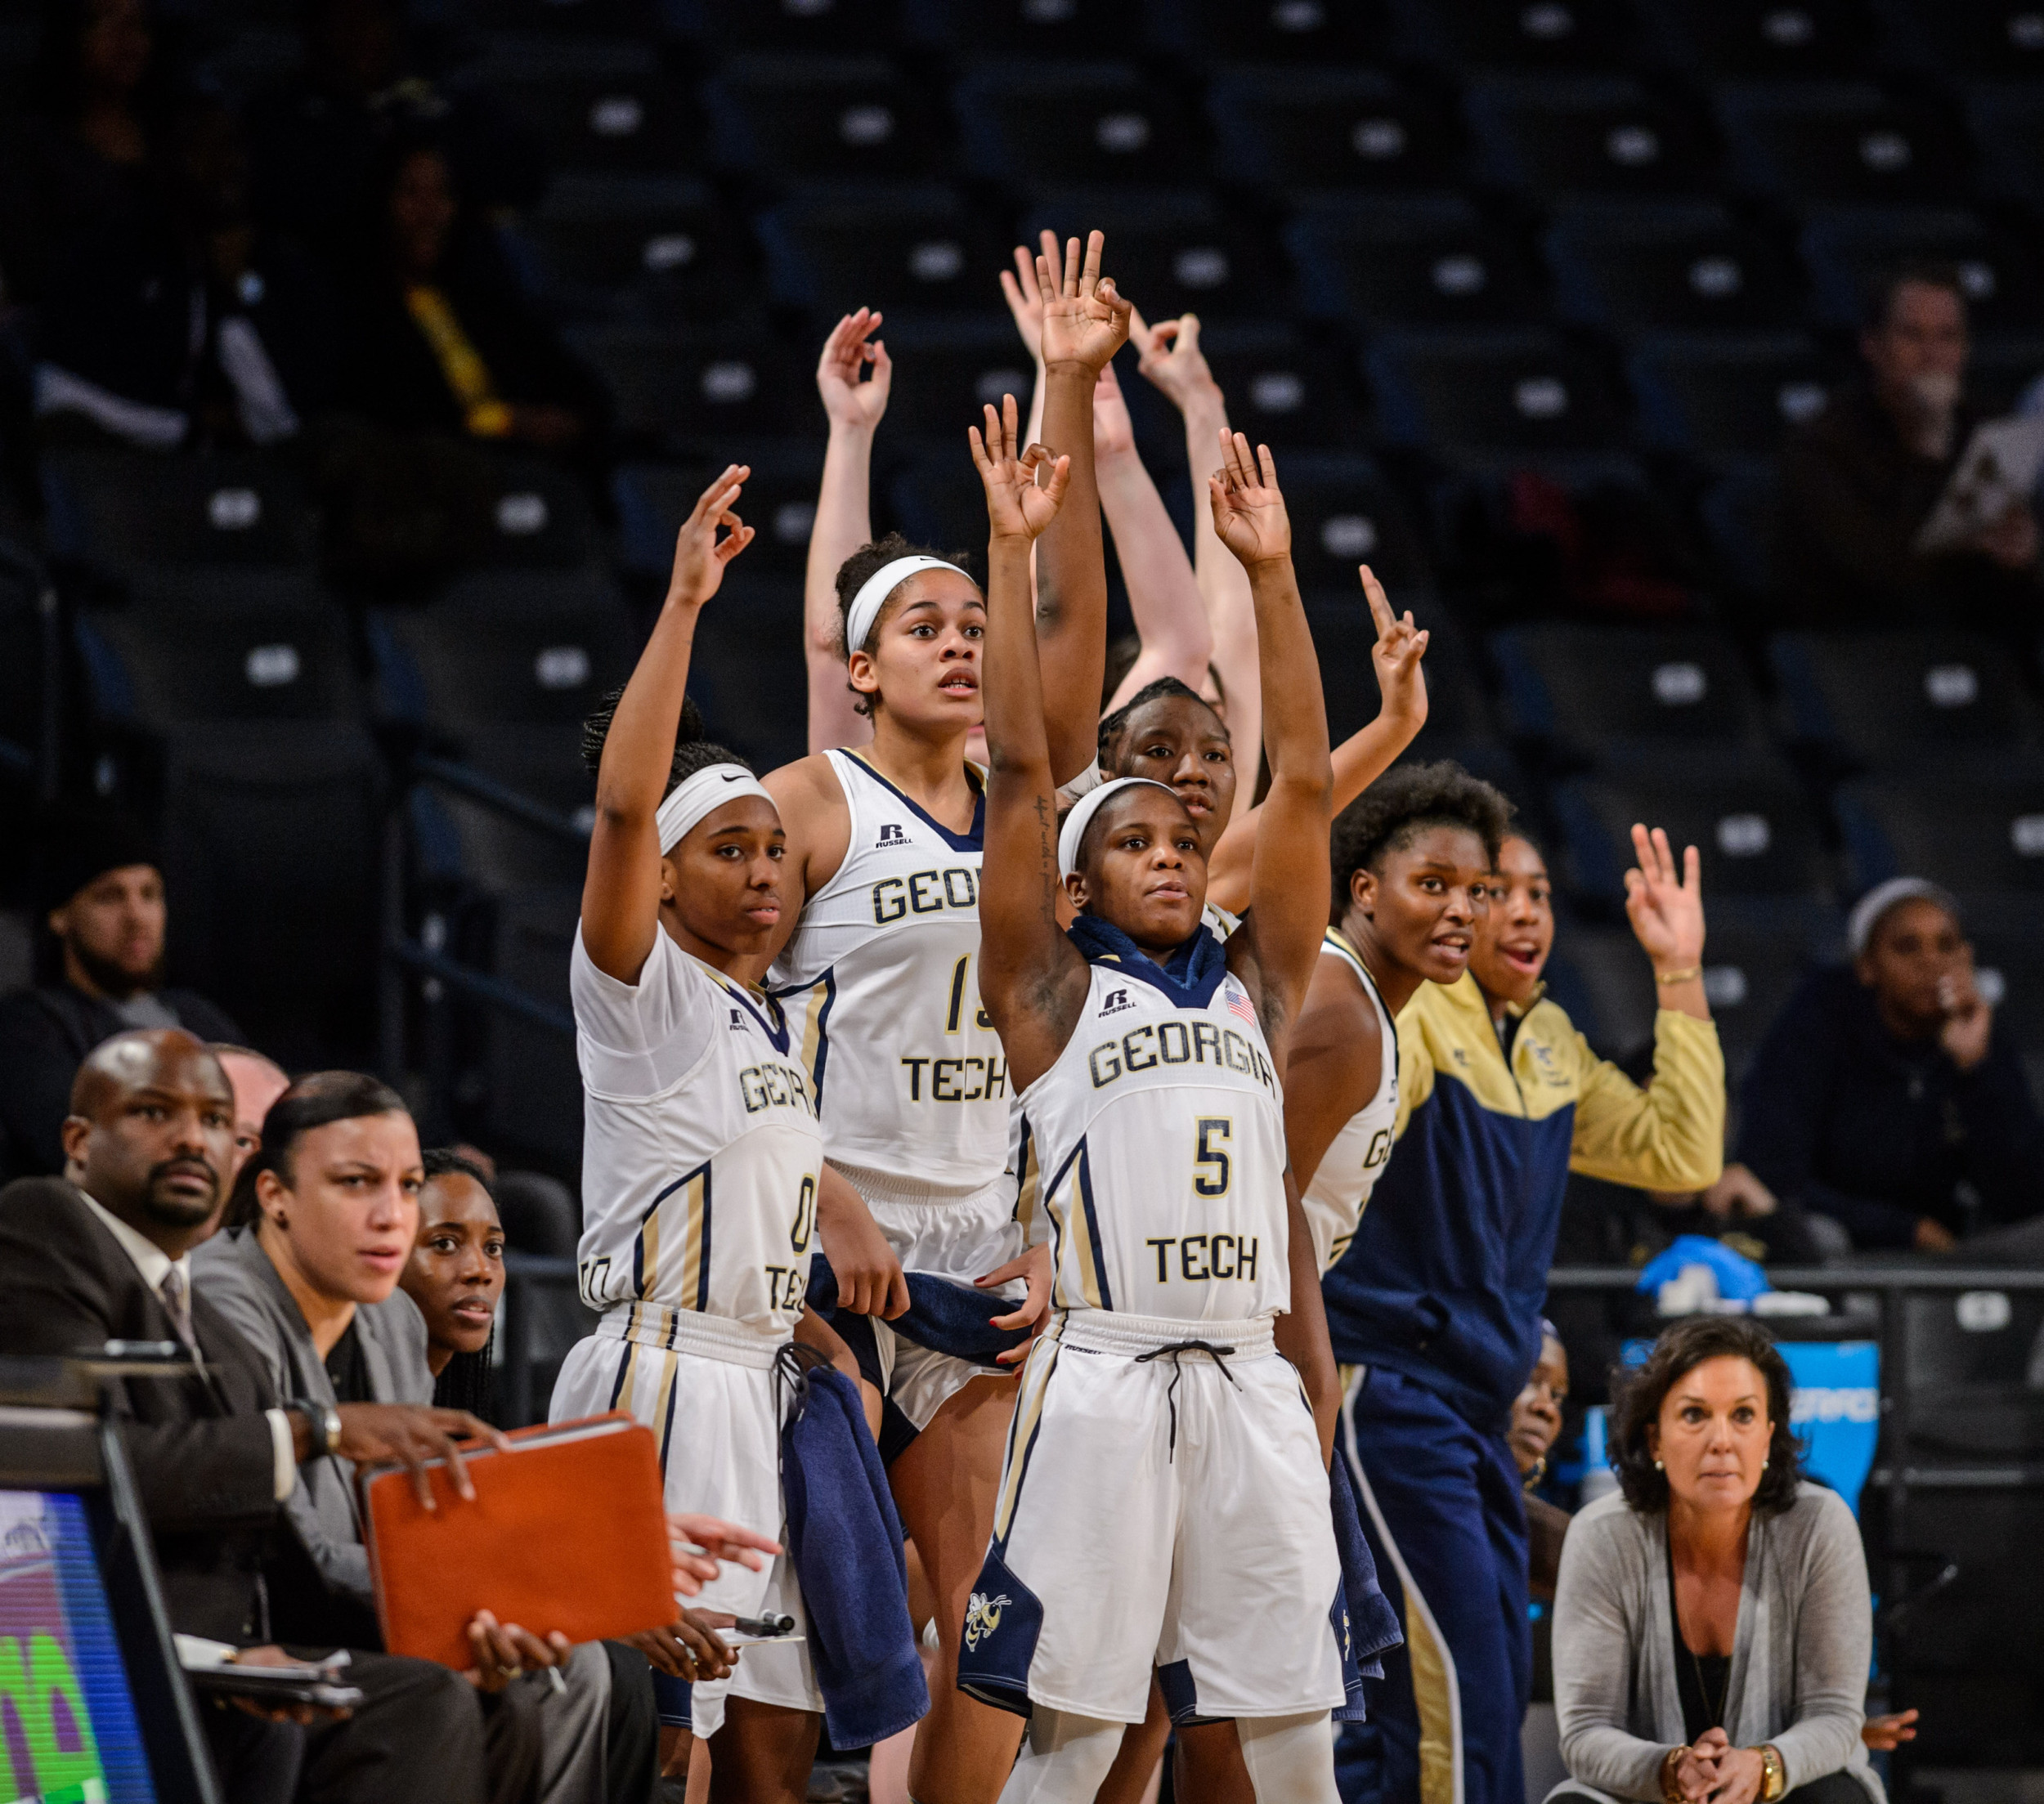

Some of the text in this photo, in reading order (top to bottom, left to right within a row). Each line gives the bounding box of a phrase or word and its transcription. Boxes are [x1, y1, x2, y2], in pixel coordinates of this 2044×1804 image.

[876, 838, 913, 848] RUSSELL
[872, 866, 982, 926] GEO
[1098, 1001, 1136, 1018] RUSSELL
[901, 1054, 1007, 1103] TECH
[1088, 1020, 1276, 1099] GEORGIA
[1192, 1116, 1233, 1200] 5
[790, 1173, 816, 1256] 0
[1145, 1233, 1258, 1284] TECH
